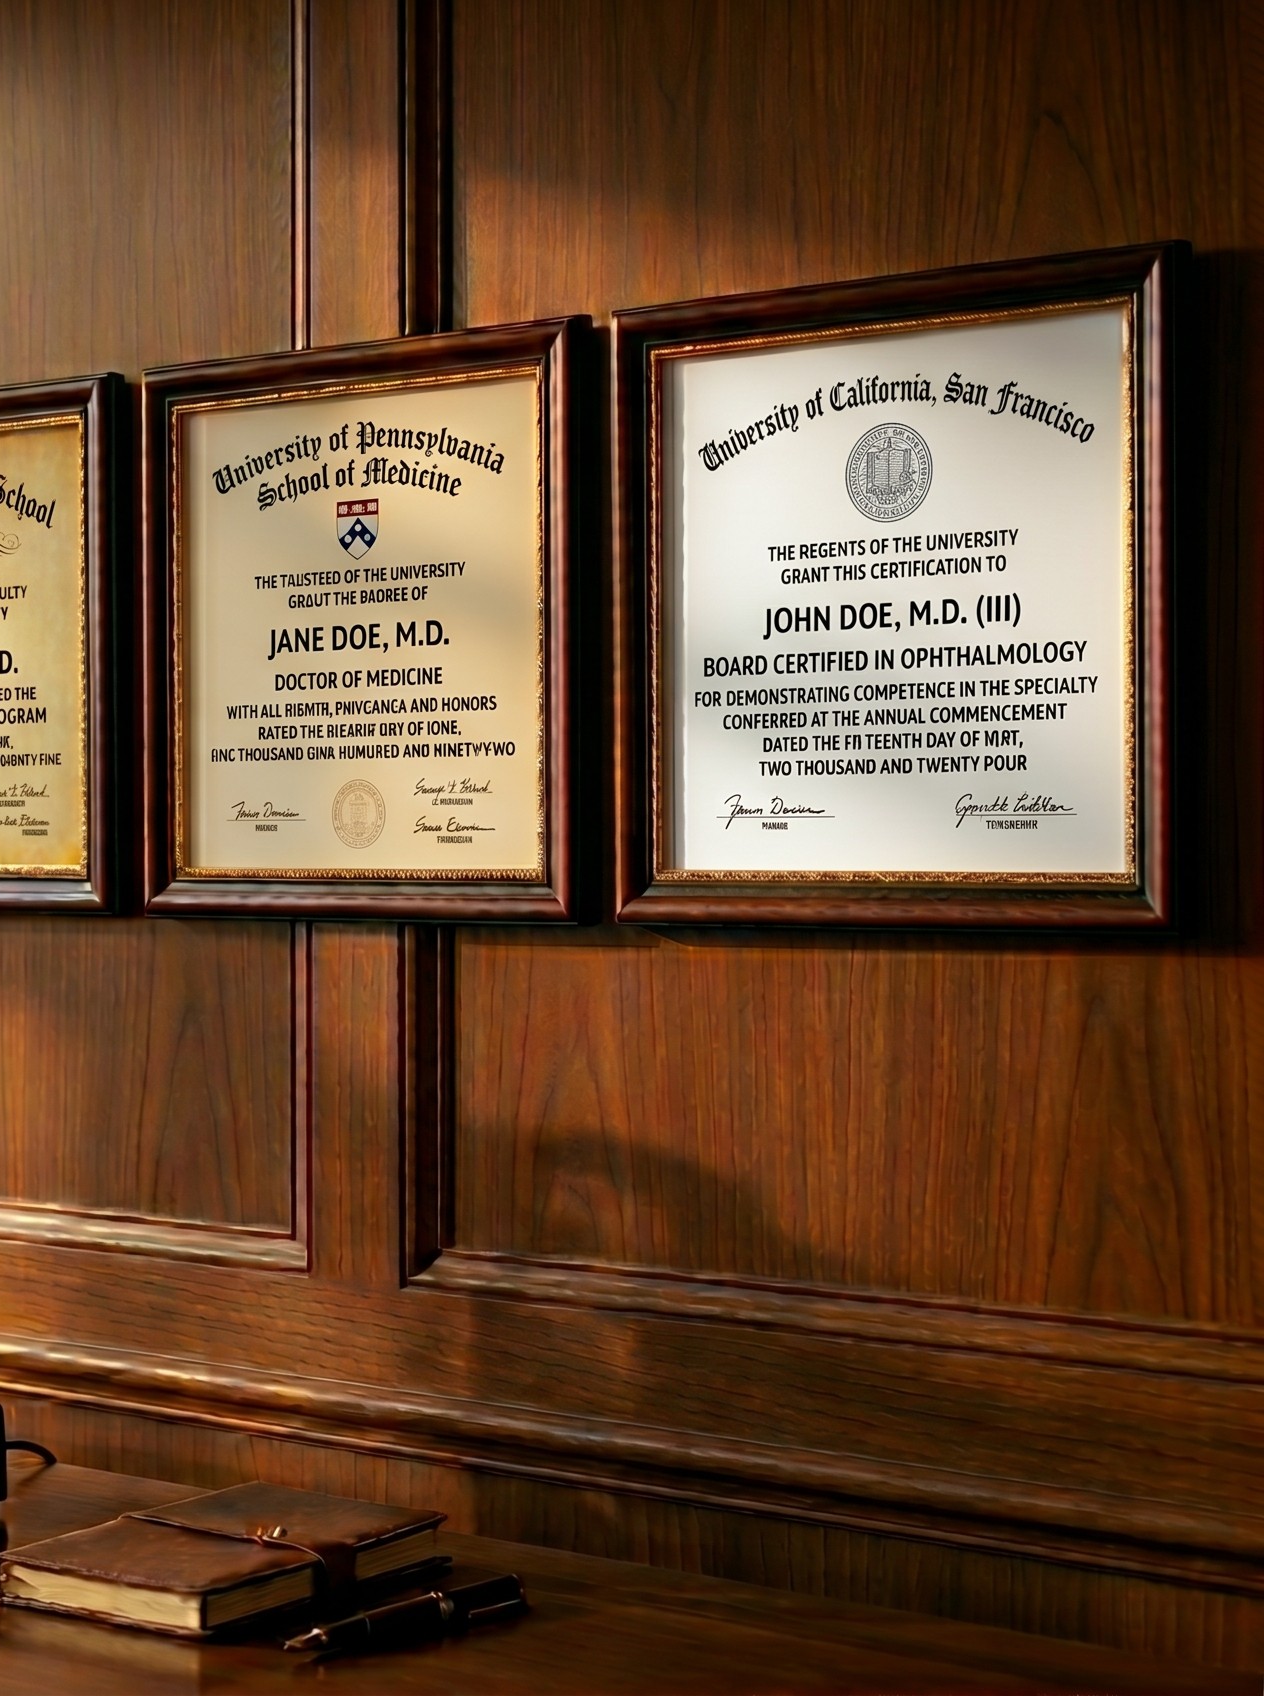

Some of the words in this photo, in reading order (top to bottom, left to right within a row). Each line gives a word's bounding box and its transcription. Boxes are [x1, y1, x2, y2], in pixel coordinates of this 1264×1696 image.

[698, 403, 800, 472] University
[805, 389, 823, 420] of
[829, 374, 937, 413] California,
[943, 372, 987, 407] San
[988, 380, 1096, 444] Francisco
[212, 435, 322, 494] University
[329, 424, 349, 452] of
[357, 421, 505, 474] Pennsylvania
[257, 462, 330, 511] School
[335, 460, 355, 487] of
[360, 457, 462, 497] Medicine
[768, 545, 795, 562] THE
[799, 540, 866, 560] REGENTS
[869, 539, 889, 557] OF
[892, 538, 921, 555] THE
[925, 529, 1019, 552] UNIVERSITY
[255, 576, 278, 589] THE
[344, 569, 361, 584] OF
[364, 567, 387, 582] THE
[390, 561, 466, 580] UNIVERSITY
[780, 567, 831, 585] GRANT
[833, 564, 866, 582] THIS
[869, 557, 981, 581] CERTIFICATION
[985, 555, 1007, 573] TO
[333, 591, 356, 606] THE
[412, 586, 428, 600] OF
[763, 607, 831, 640] JOHN
[840, 602, 902, 632] DOE,
[909, 599, 967, 627] M.D.
[976, 593, 1021, 629] (III)
[268, 626, 324, 660] JANE
[332, 623, 389, 652] DOE,
[396, 620, 450, 647] M.D.
[703, 655, 768, 678] BOARD
[773, 650, 869, 675] CERTIFIED
[874, 650, 895, 671] IN
[900, 640, 1087, 670] OPHTHALMOLOGY
[275, 672, 338, 691] DOCTOR
[342, 671, 362, 687] OF
[367, 667, 443, 687] MEDICINE
[694, 691, 721, 707] FOR
[726, 686, 850, 706] DEMONSTRATING
[854, 681, 956, 701] COMPETENCE
[959, 681, 976, 698] IN
[979, 679, 1010, 697] THE
[1014, 676, 1098, 696] SPECIALTY
[14, 687, 37, 700] THE
[227, 705, 259, 719] WITH
[261, 704, 282, 718] ALL
[410, 697, 437, 713] AND
[441, 696, 497, 711] HONORS
[723, 712, 808, 730] CONFERRED
[810, 711, 829, 727] AT
[832, 710, 860, 727] THE
[864, 707, 925, 726] ANNUAL
[929, 703, 1068, 724] COMMENCEMENT
[259, 725, 297, 740] RATED
[300, 724, 324, 738] THE
[408, 721, 424, 735] OF
[762, 736, 809, 752] DATED
[812, 735, 841, 751] THE
[925, 731, 956, 748] DAY
[960, 730, 980, 747] OF
[39, 753, 62, 765] FINE
[238, 747, 304, 761] THOUSAND
[759, 760, 792, 777] TWO
[795, 758, 877, 775] THOUSAND
[879, 758, 913, 775] AND
[916, 755, 981, 774] TWENTY
[984, 754, 1027, 773] POUR
